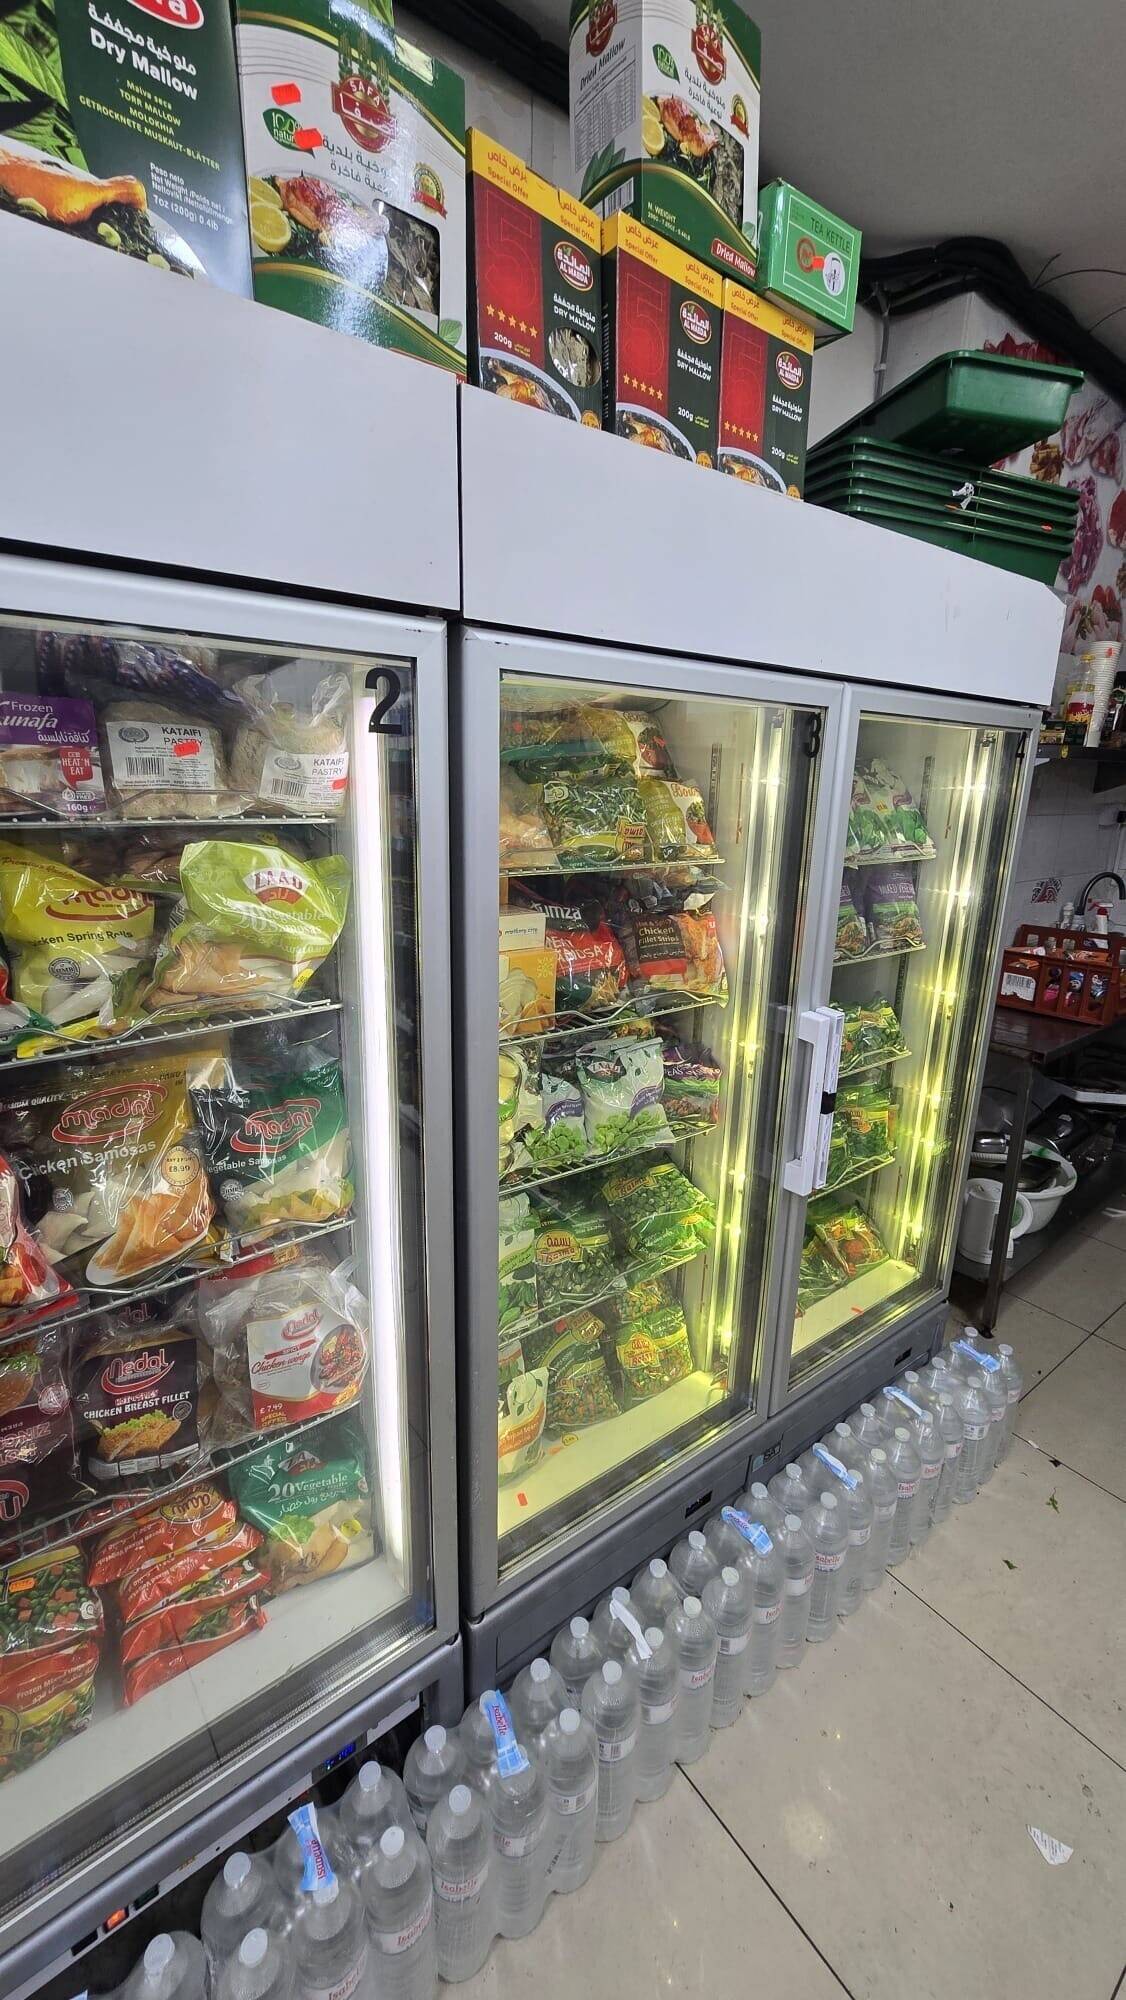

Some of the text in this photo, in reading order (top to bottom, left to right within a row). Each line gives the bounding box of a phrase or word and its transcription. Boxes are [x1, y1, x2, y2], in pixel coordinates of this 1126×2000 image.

[90, 27, 198, 100] Dry Mallow
[580, 68, 597, 91] Dried
[349, 81, 381, 107] SAFA
[79, 95, 142, 132] GETROCKNETE
[119, 88, 181, 127] TORR MALLOW
[130, 107, 174, 136] MOLOKHIA
[323, 135, 353, 161] بلدية
[488, 151, 508, 169] خاص
[151, 163, 169, 178] Peso
[330, 160, 361, 184] فاخرة
[165, 177, 188, 197] Weight
[488, 167, 529, 200] Special Offer
[171, 203, 197, 223] (200g)
[578, 212, 595, 229] عرض
[560, 215, 595, 244] Special Offer
[810, 217, 851, 253] TEA KETTLE
[625, 239, 658, 264] Special Offer
[717, 242, 756, 278] Dried Mallow
[559, 260, 569, 273] AL
[685, 275, 714, 299] Special Offer
[554, 306, 596, 333] DRY MALLOW
[684, 320, 692, 330] AL
[494, 332, 512, 350] 200g
[677, 359, 711, 382] DRY MALLOW
[677, 406, 693, 423] 200g
[772, 405, 802, 423] DRY MALLOW
[771, 446, 785, 460] 200g
[11, 701, 53, 713] Frozen
[365, 667, 402, 735] 2
[0, 711, 58, 731] unafa
[161, 726, 202, 737] KATAIFI
[804, 712, 822, 759] 3
[70, 767, 85, 776] EAT
[312, 767, 344, 776] PASTRY
[313, 757, 344, 767] KATAIFI
[67, 803, 88, 812] 160g
[255, 870, 303, 890] LAAD
[67, 931, 105, 943] Spring
[639, 926, 674, 936] Chicken
[61, 1097, 155, 1130] madni
[245, 1107, 314, 1140] madni
[80, 1141, 157, 1166] Samosas
[207, 1160, 246, 1174] egetable
[251, 1359, 286, 1375] Chicken
[83, 1407, 122, 1420] CHICKEN
[124, 1397, 160, 1413] BREAST
[161, 1391, 190, 1405] FILLET
[266, 1402, 283, 1412] 7.49
[268, 1472, 348, 1503] 20 Vegetable
[16, 1685, 43, 1701] Frozen
[492, 1705, 508, 1736] Isabelle
[440, 1878, 479, 1894] Isabelle
